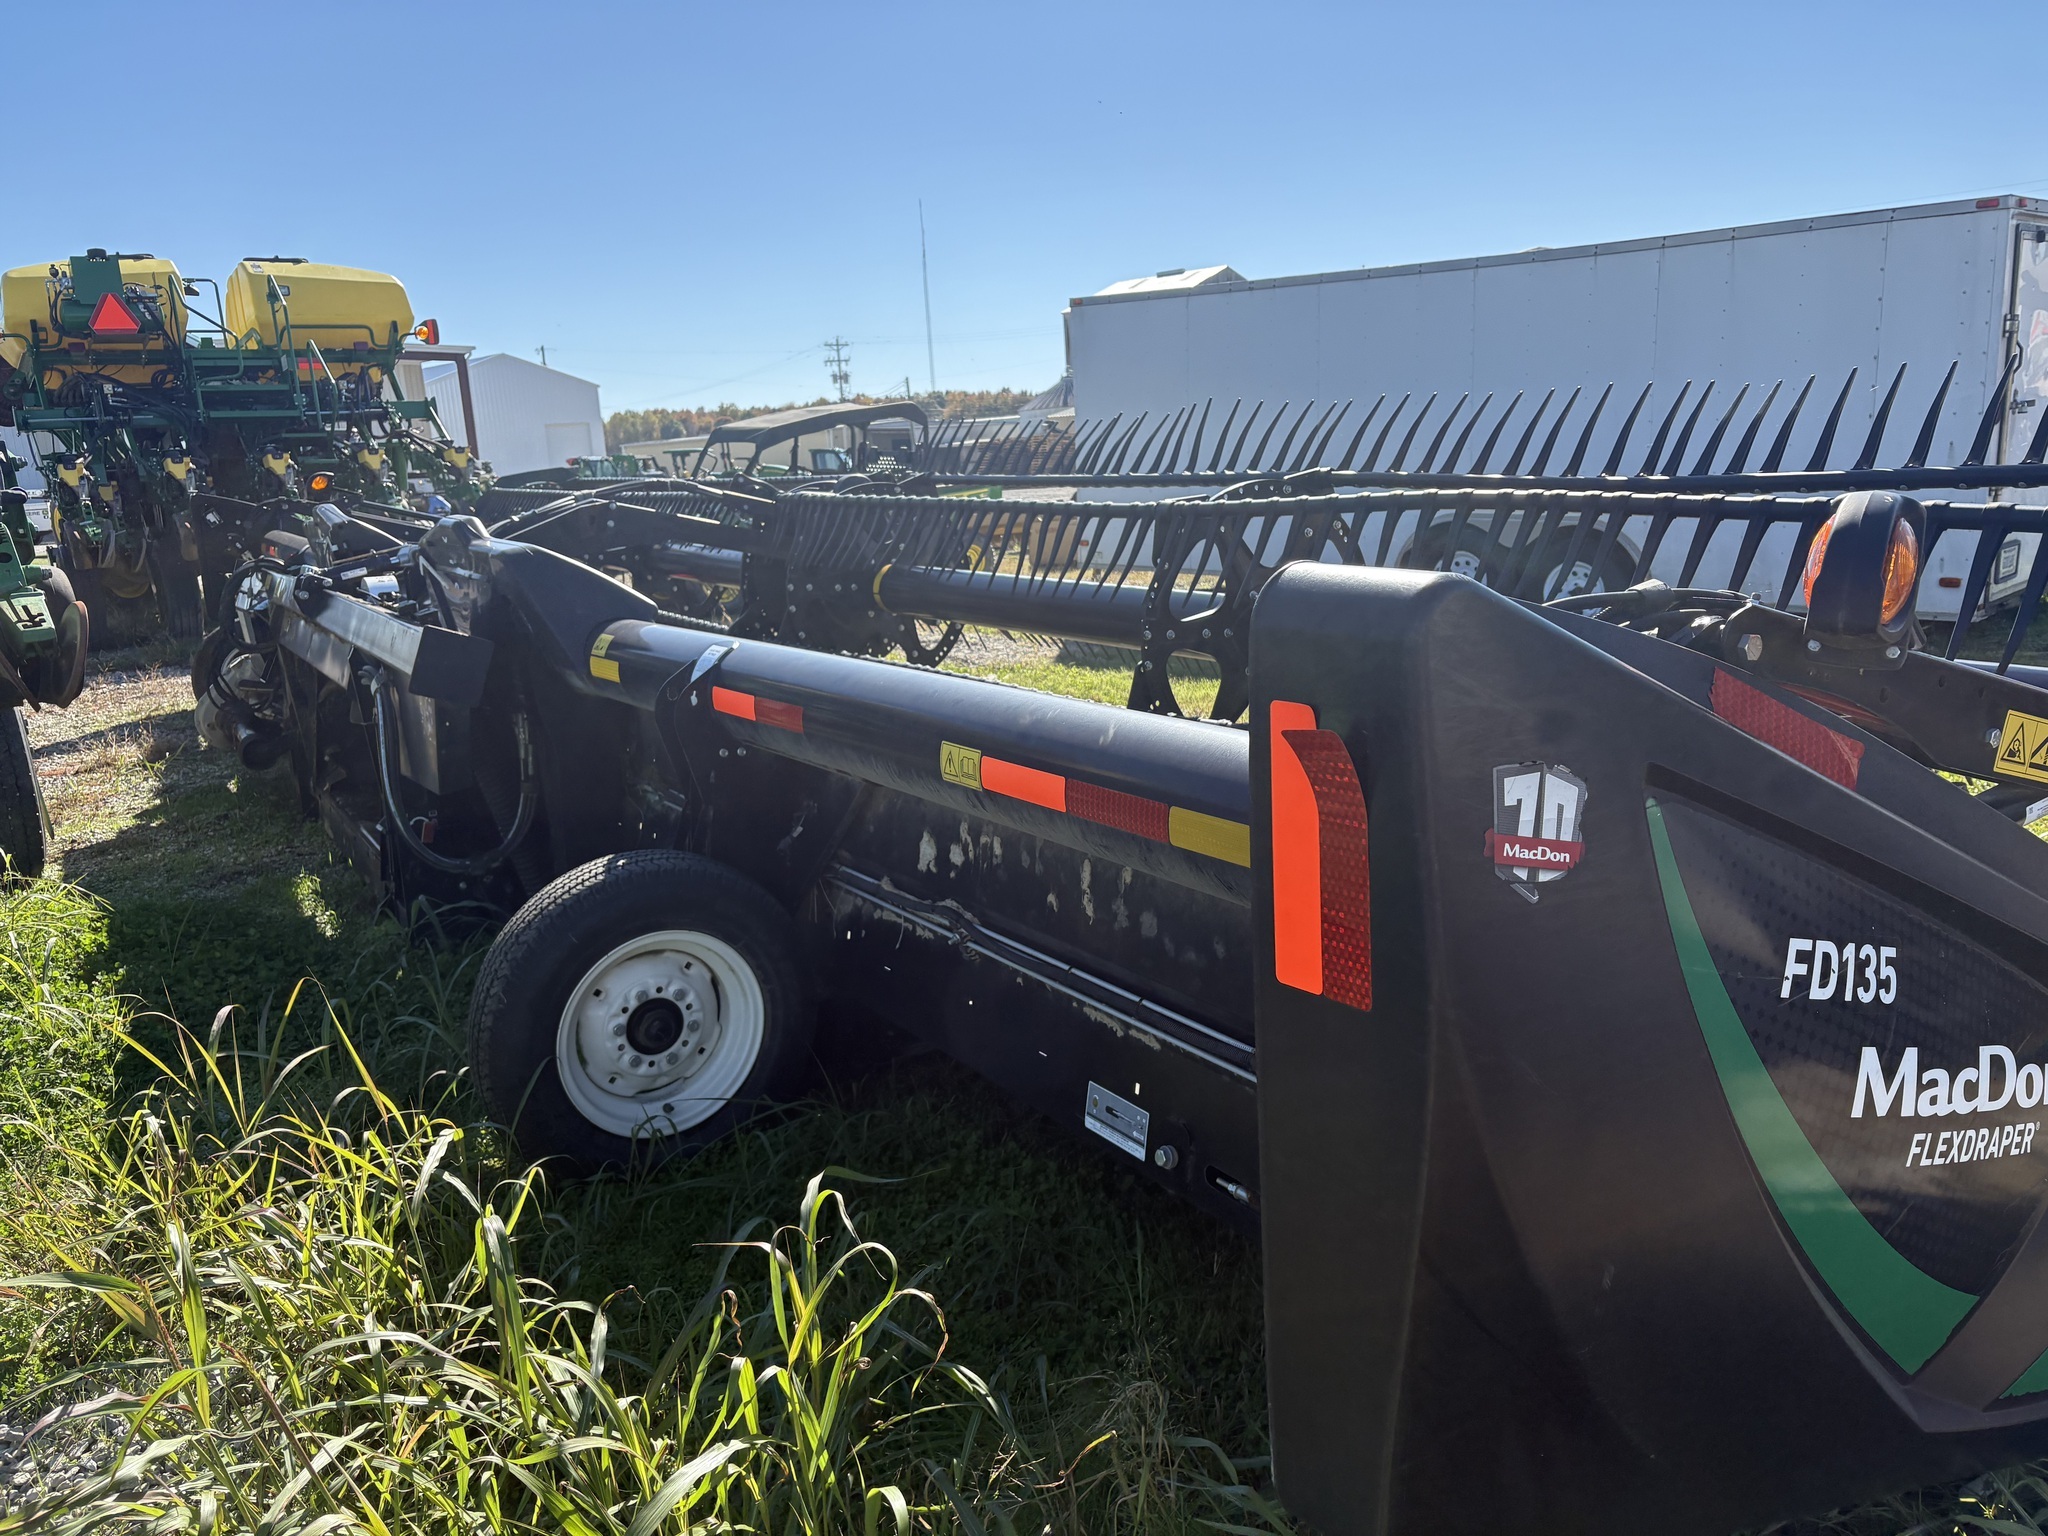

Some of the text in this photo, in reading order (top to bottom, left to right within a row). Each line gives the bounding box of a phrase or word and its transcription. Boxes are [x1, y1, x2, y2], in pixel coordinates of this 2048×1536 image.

[1503, 842, 1570, 863] MacDon
[1780, 937, 1897, 1005] FD135
[1850, 1045, 2048, 1118] MacDo
